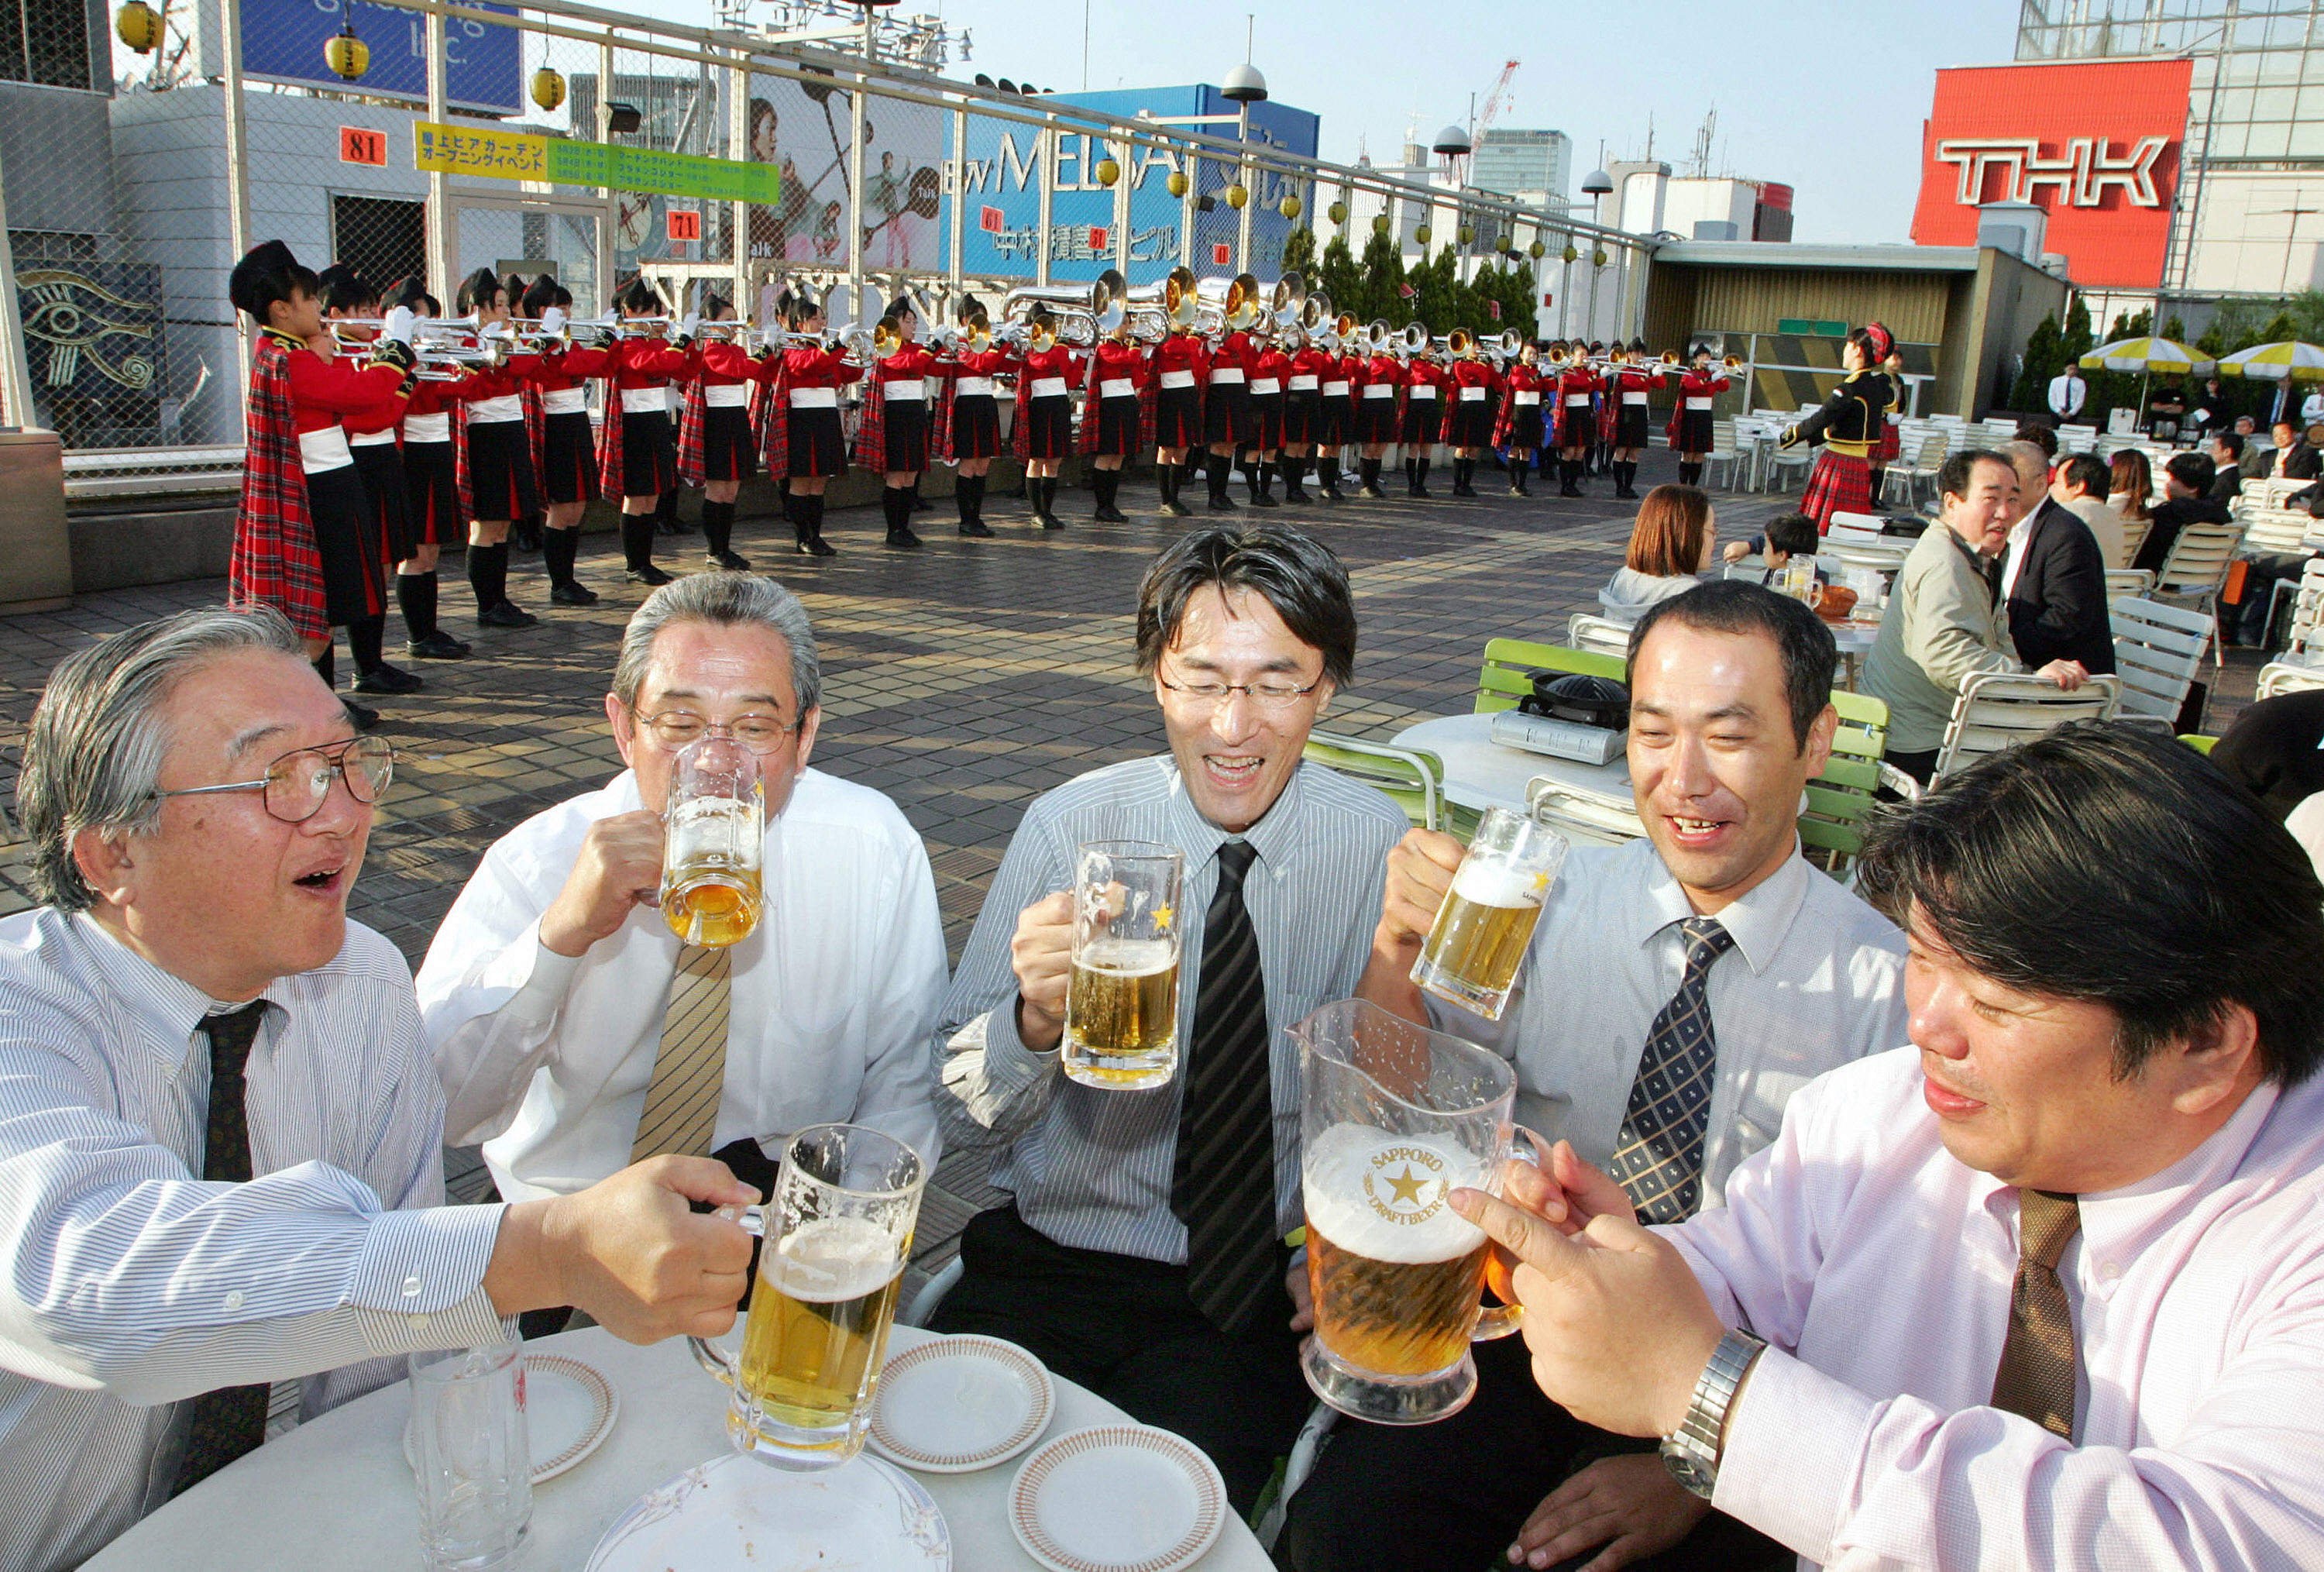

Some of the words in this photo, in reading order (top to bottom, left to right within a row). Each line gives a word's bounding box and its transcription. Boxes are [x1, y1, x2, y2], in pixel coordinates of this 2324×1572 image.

[350, 132, 376, 162] 81
[423, 147, 542, 171] オープニングイベント
[1935, 136, 2170, 206] THK
[675, 215, 693, 237] 71
[751, 241, 772, 257] alk
[1371, 1147, 1443, 1171] SAPPORO
[1368, 1195, 1405, 1225] DRAFT
[1409, 1200, 1443, 1225] BEER
